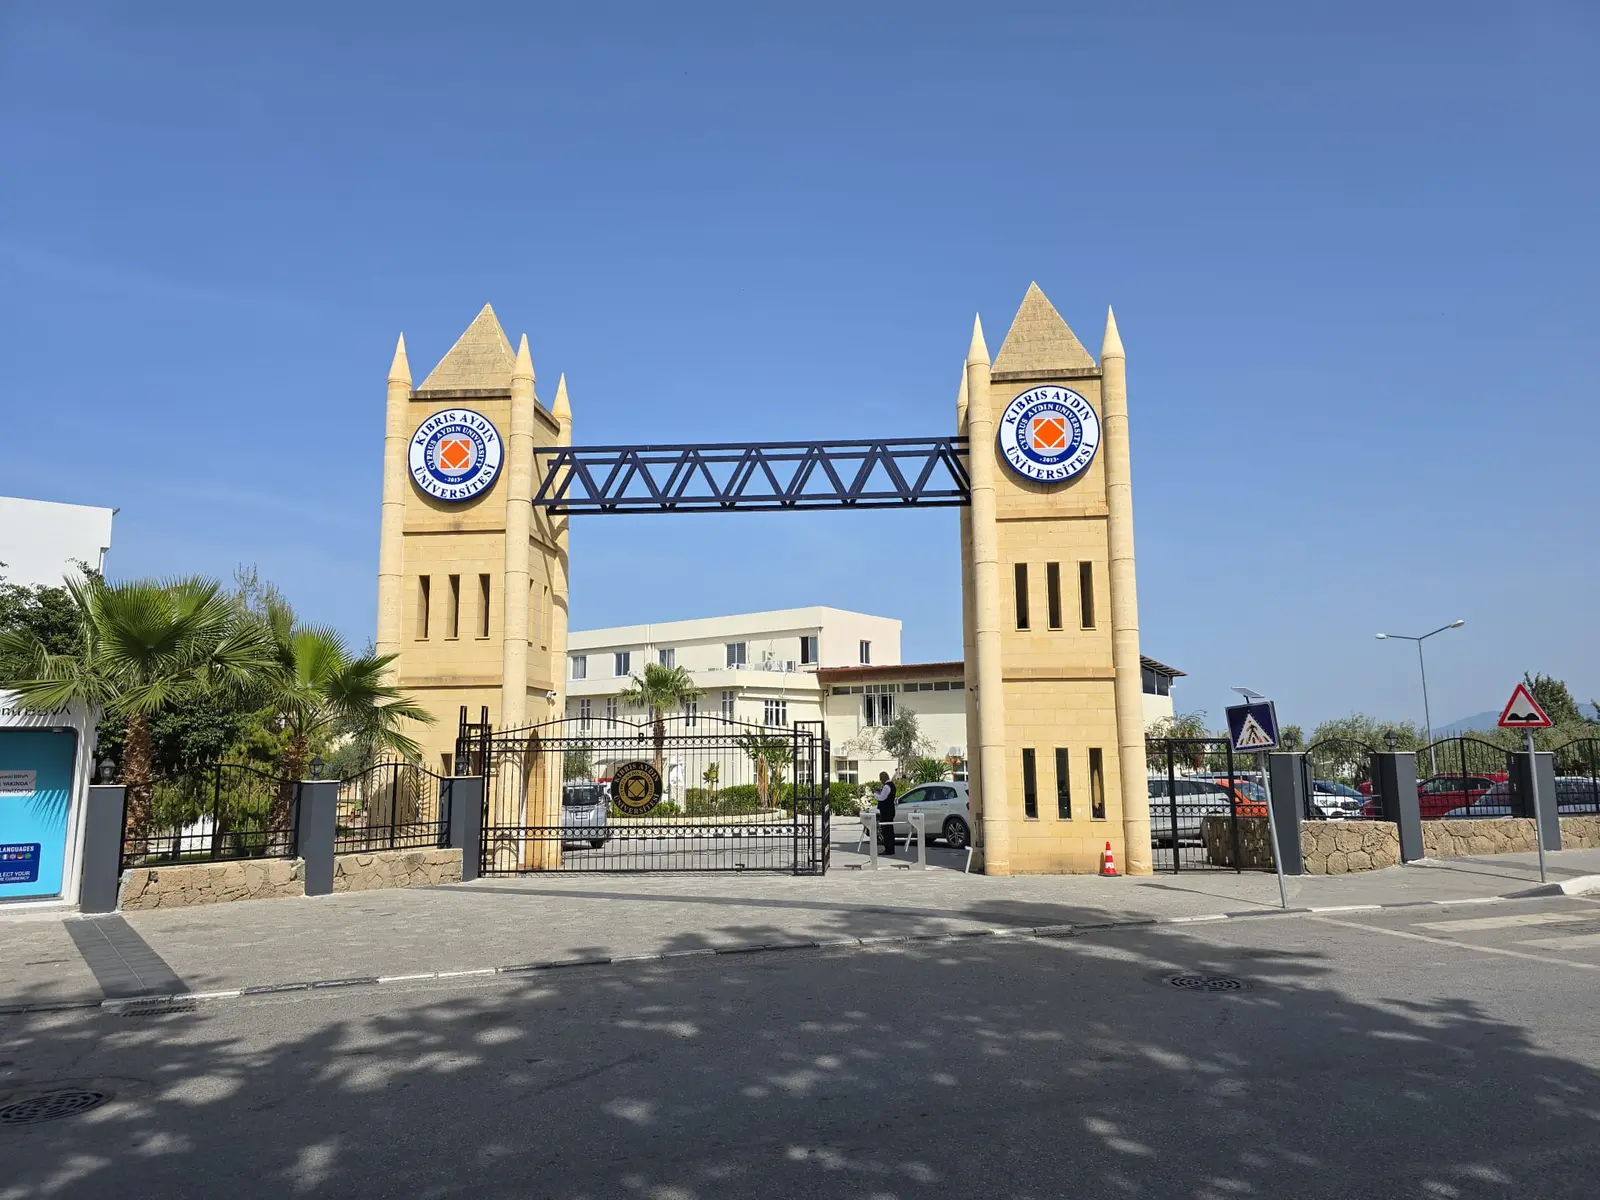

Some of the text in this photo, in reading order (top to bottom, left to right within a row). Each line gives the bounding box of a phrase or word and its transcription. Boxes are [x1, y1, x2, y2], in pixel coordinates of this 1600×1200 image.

[1005, 390, 1092, 425] KIBRIS AYDIN
[415, 412, 496, 446] KIBRIS AYDIN
[1018, 403, 1081, 451] CYPRUS AYDIN UNIVERSITY
[426, 426, 485, 470] CYPRUS AYDIN UNIVERSITY
[1006, 441, 1094, 479] ÜNİVERSİTESİ
[414, 463, 496, 498] ÜNİVERSİTESİ
[638, 764, 660, 781] AYDIN
[0, 845, 35, 853] LANGUAGES
